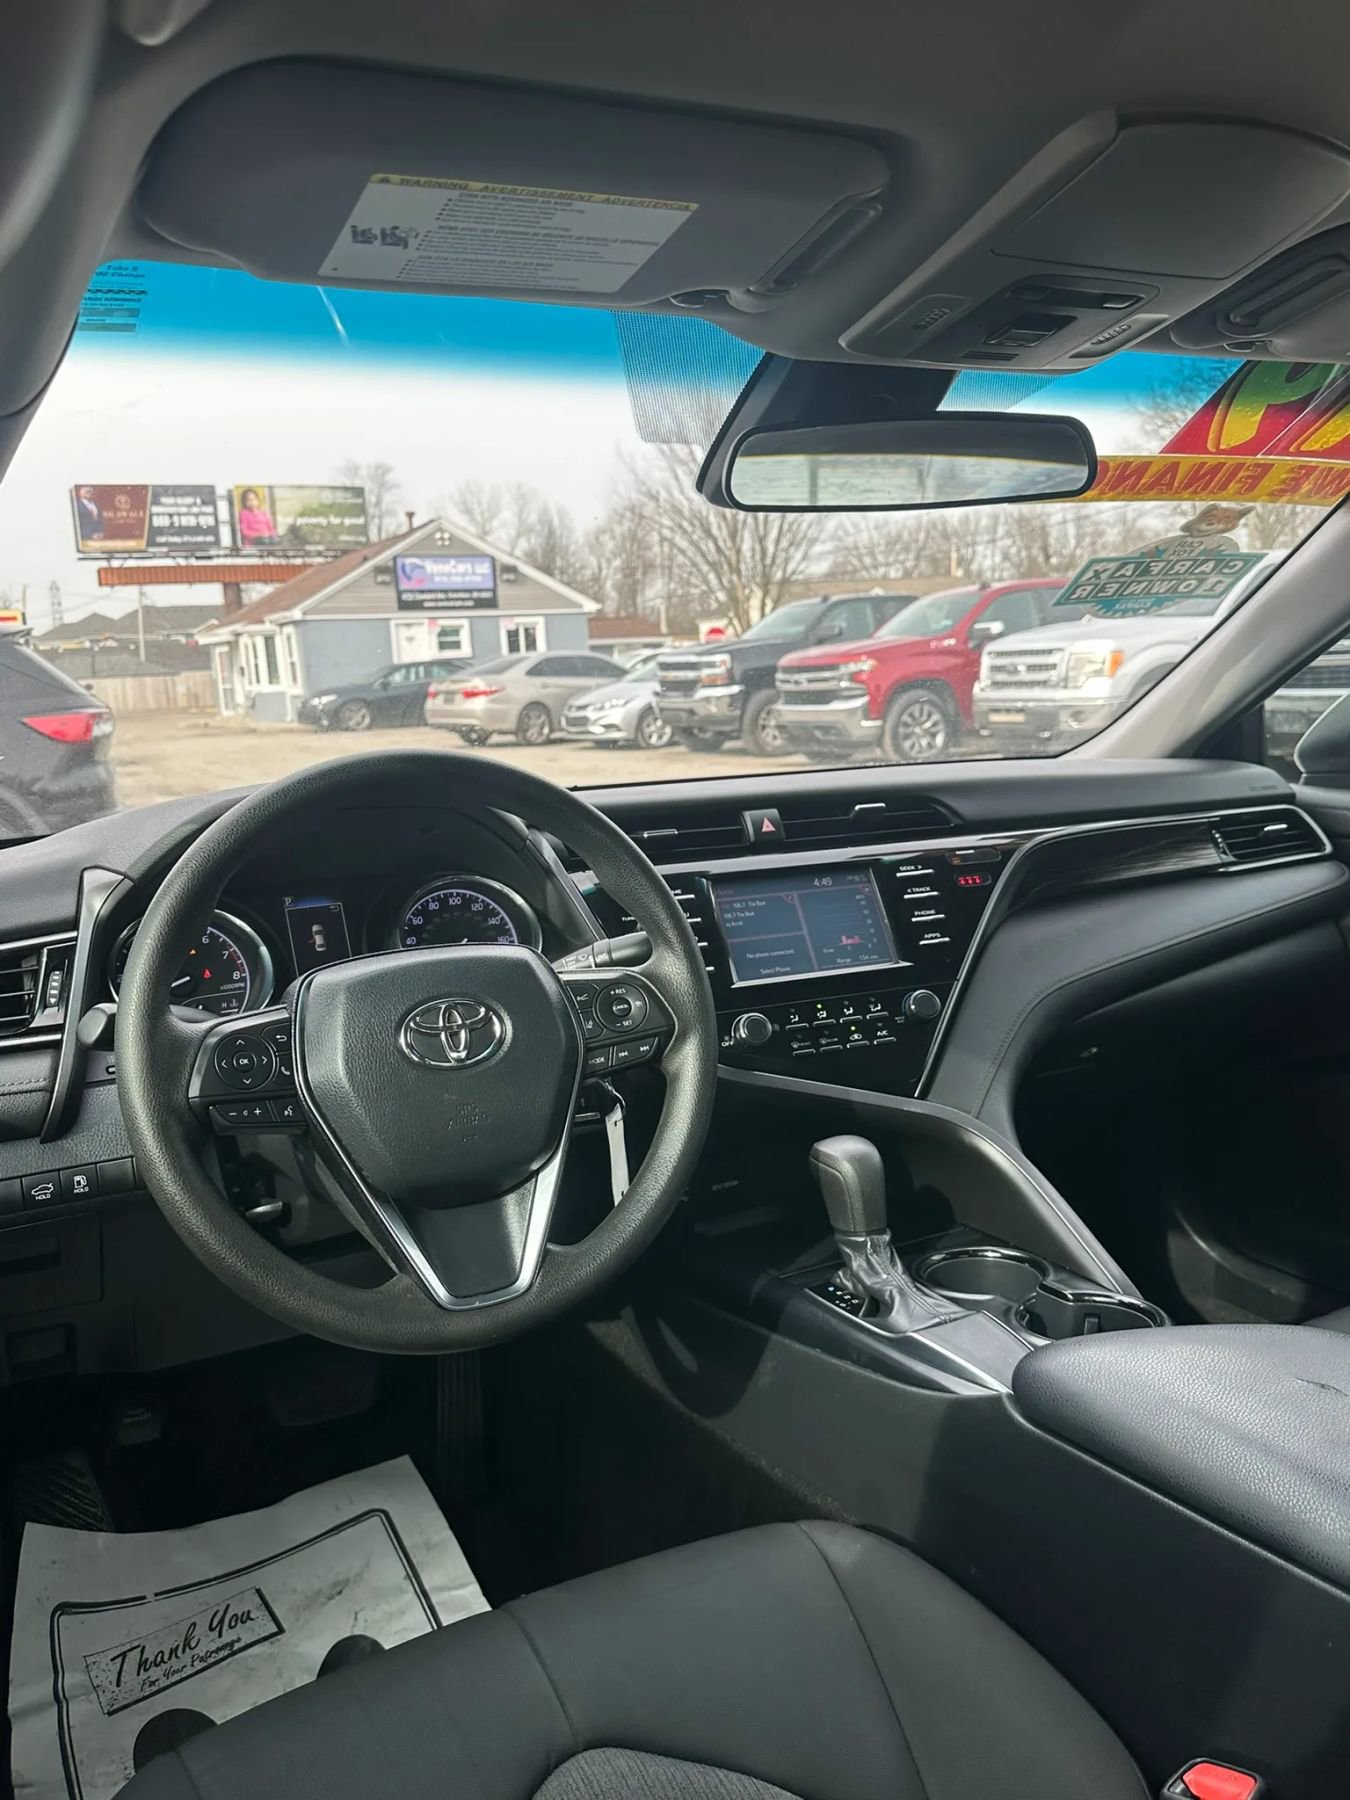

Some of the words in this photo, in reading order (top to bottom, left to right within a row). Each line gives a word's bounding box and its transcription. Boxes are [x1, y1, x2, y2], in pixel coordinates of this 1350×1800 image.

[400, 177, 469, 191] WARNING
[480, 184, 594, 202] AVERTISSEMENT
[604, 196, 691, 212] ADVERTENCIA
[813, 876, 833, 887] 4:49
[449, 897, 461, 905] 100
[429, 902, 439, 910] 80
[471, 903, 483, 911] 120
[412, 916, 423, 925] 60
[488, 917, 500, 925] 140
[202, 936, 209, 944] 6
[406, 937, 416, 945] 40
[222, 951, 229, 959] 7
[233, 971, 240, 980] 8
[73, 1186, 89, 1194] HOLD
[35, 1193, 51, 1201] HOLD
[110, 1621, 202, 1687] Thank
[208, 1603, 255, 1639] You
[140, 1677, 161, 1692] For
[163, 1664, 188, 1680] Your
